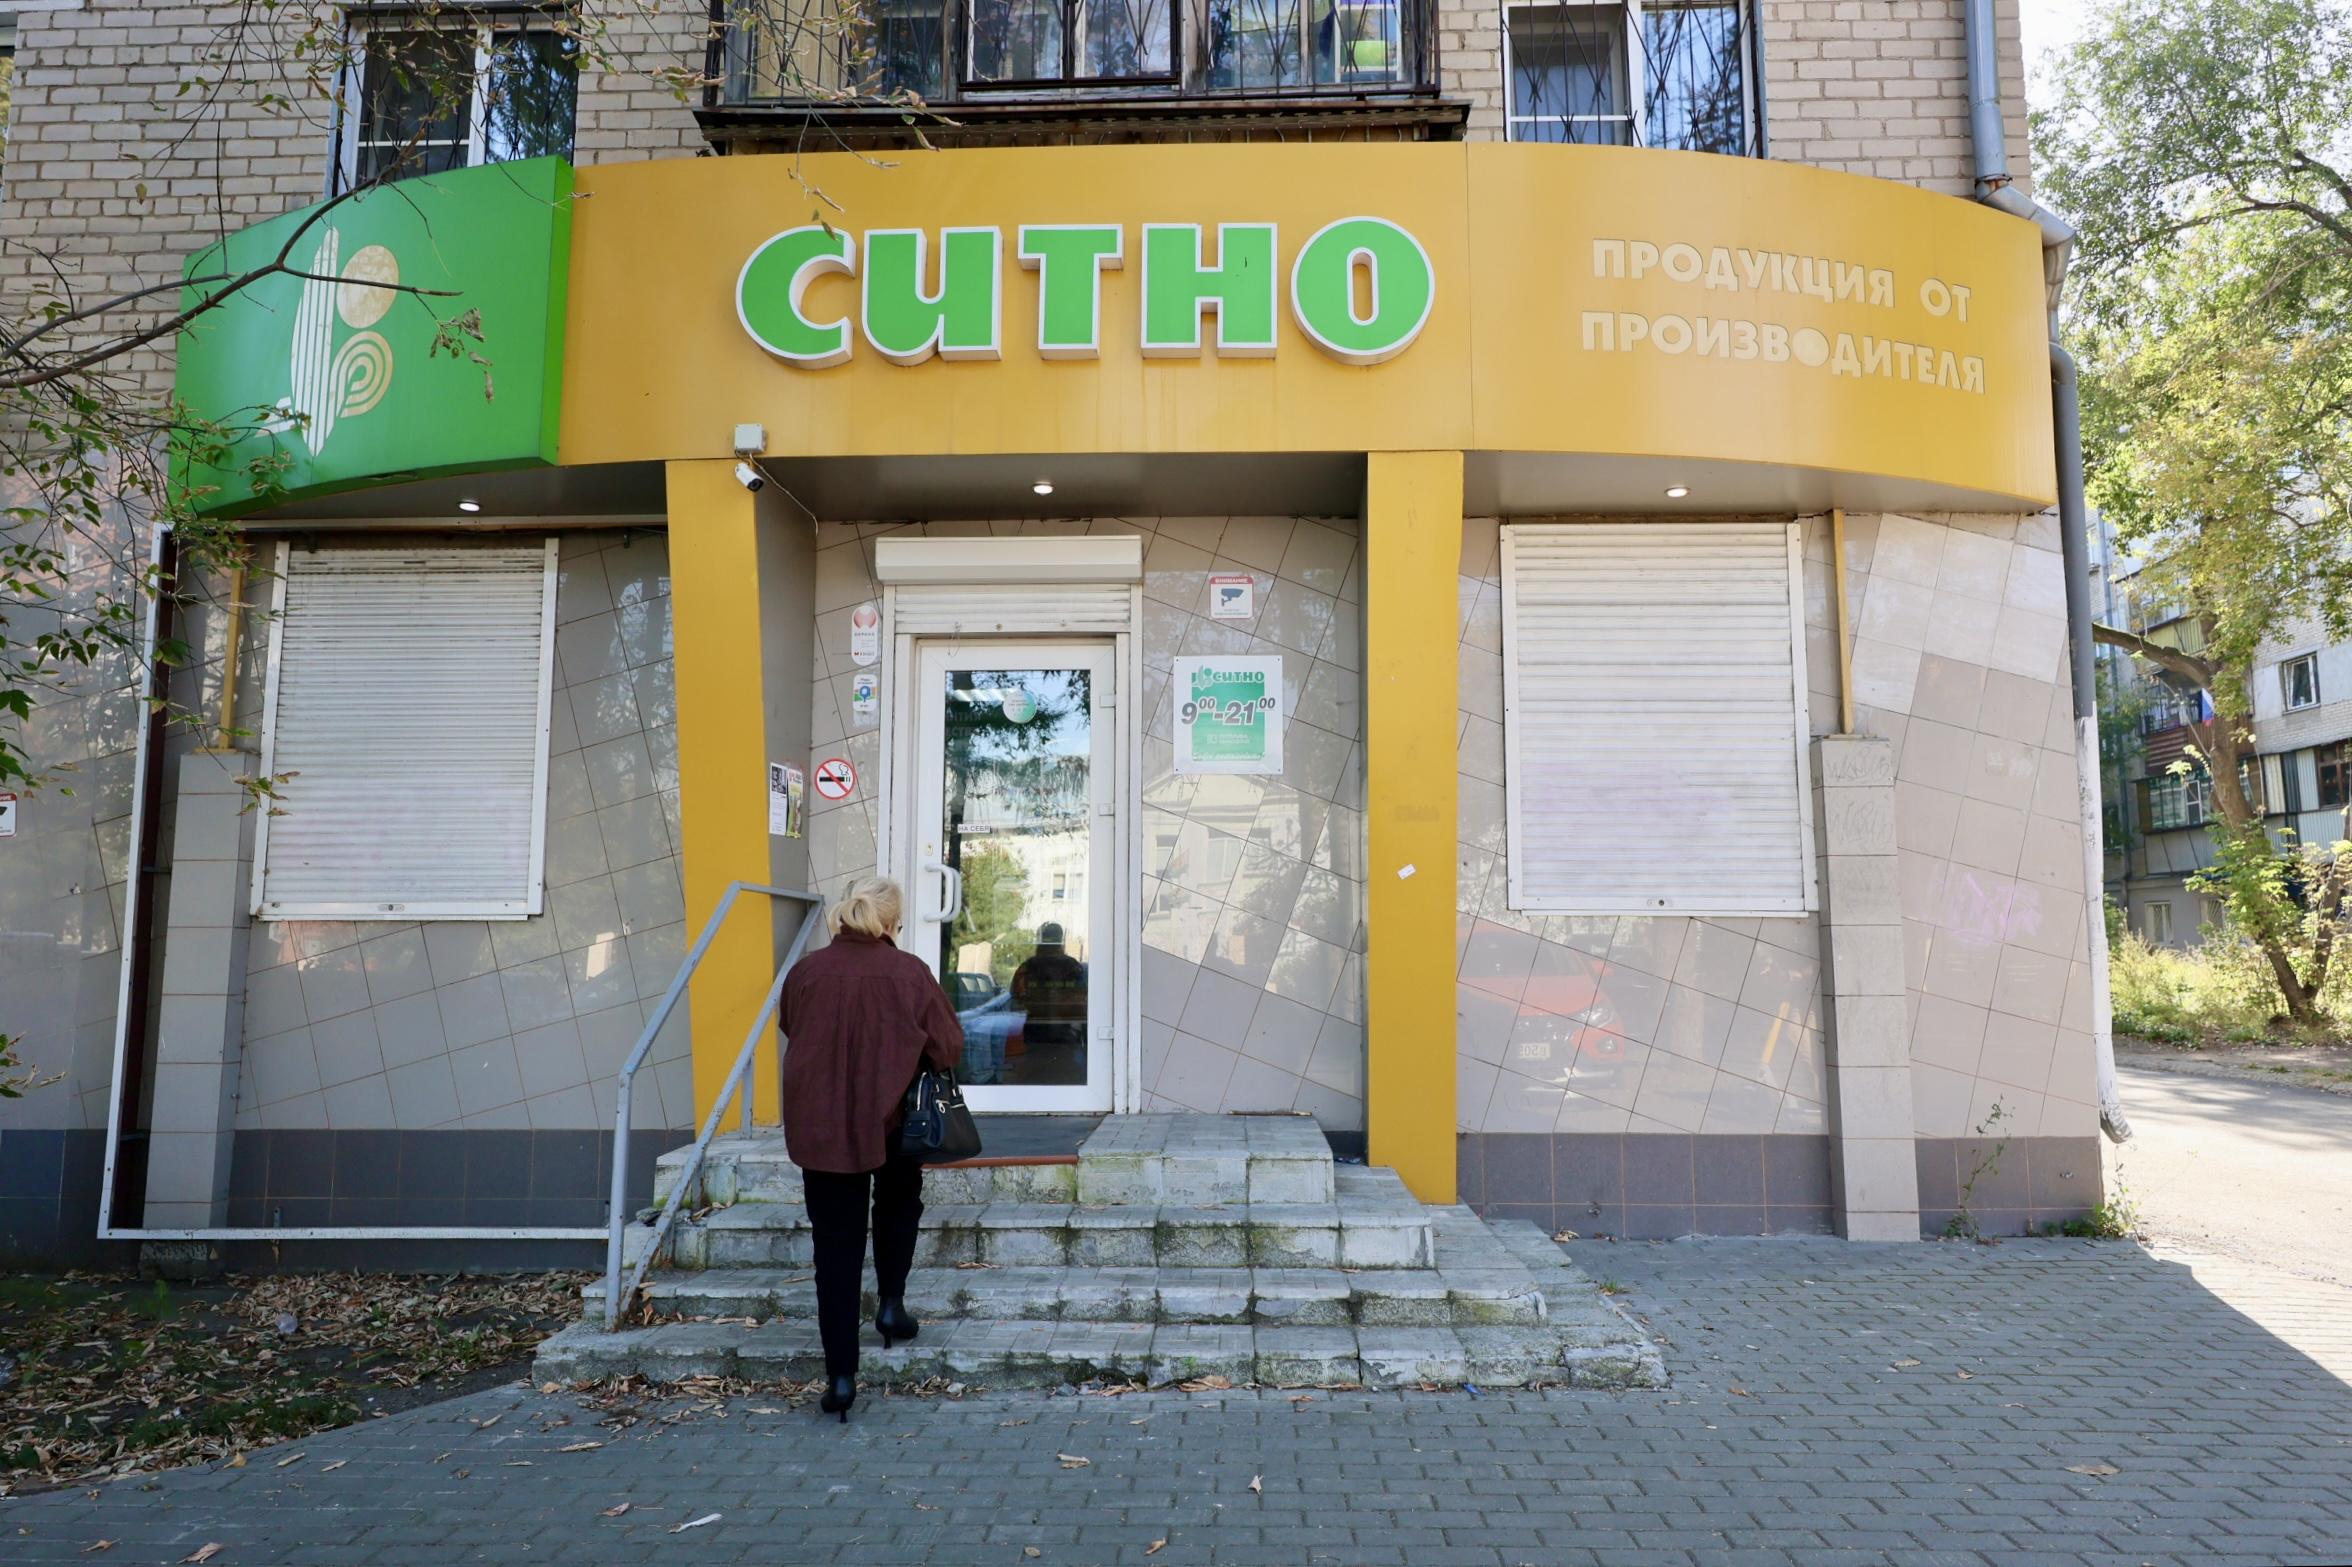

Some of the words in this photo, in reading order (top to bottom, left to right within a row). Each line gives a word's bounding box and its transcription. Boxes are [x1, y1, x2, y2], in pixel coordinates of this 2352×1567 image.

[735, 215, 1436, 369] СИТНО
[1592, 239, 1896, 308] ПРОДУКЦИЯ
[1919, 277, 1972, 323] ОТ
[1582, 310, 1986, 395] ПРОИЗВОДИТЕЛЯ
[1213, 671, 1265, 682] СИТНО
